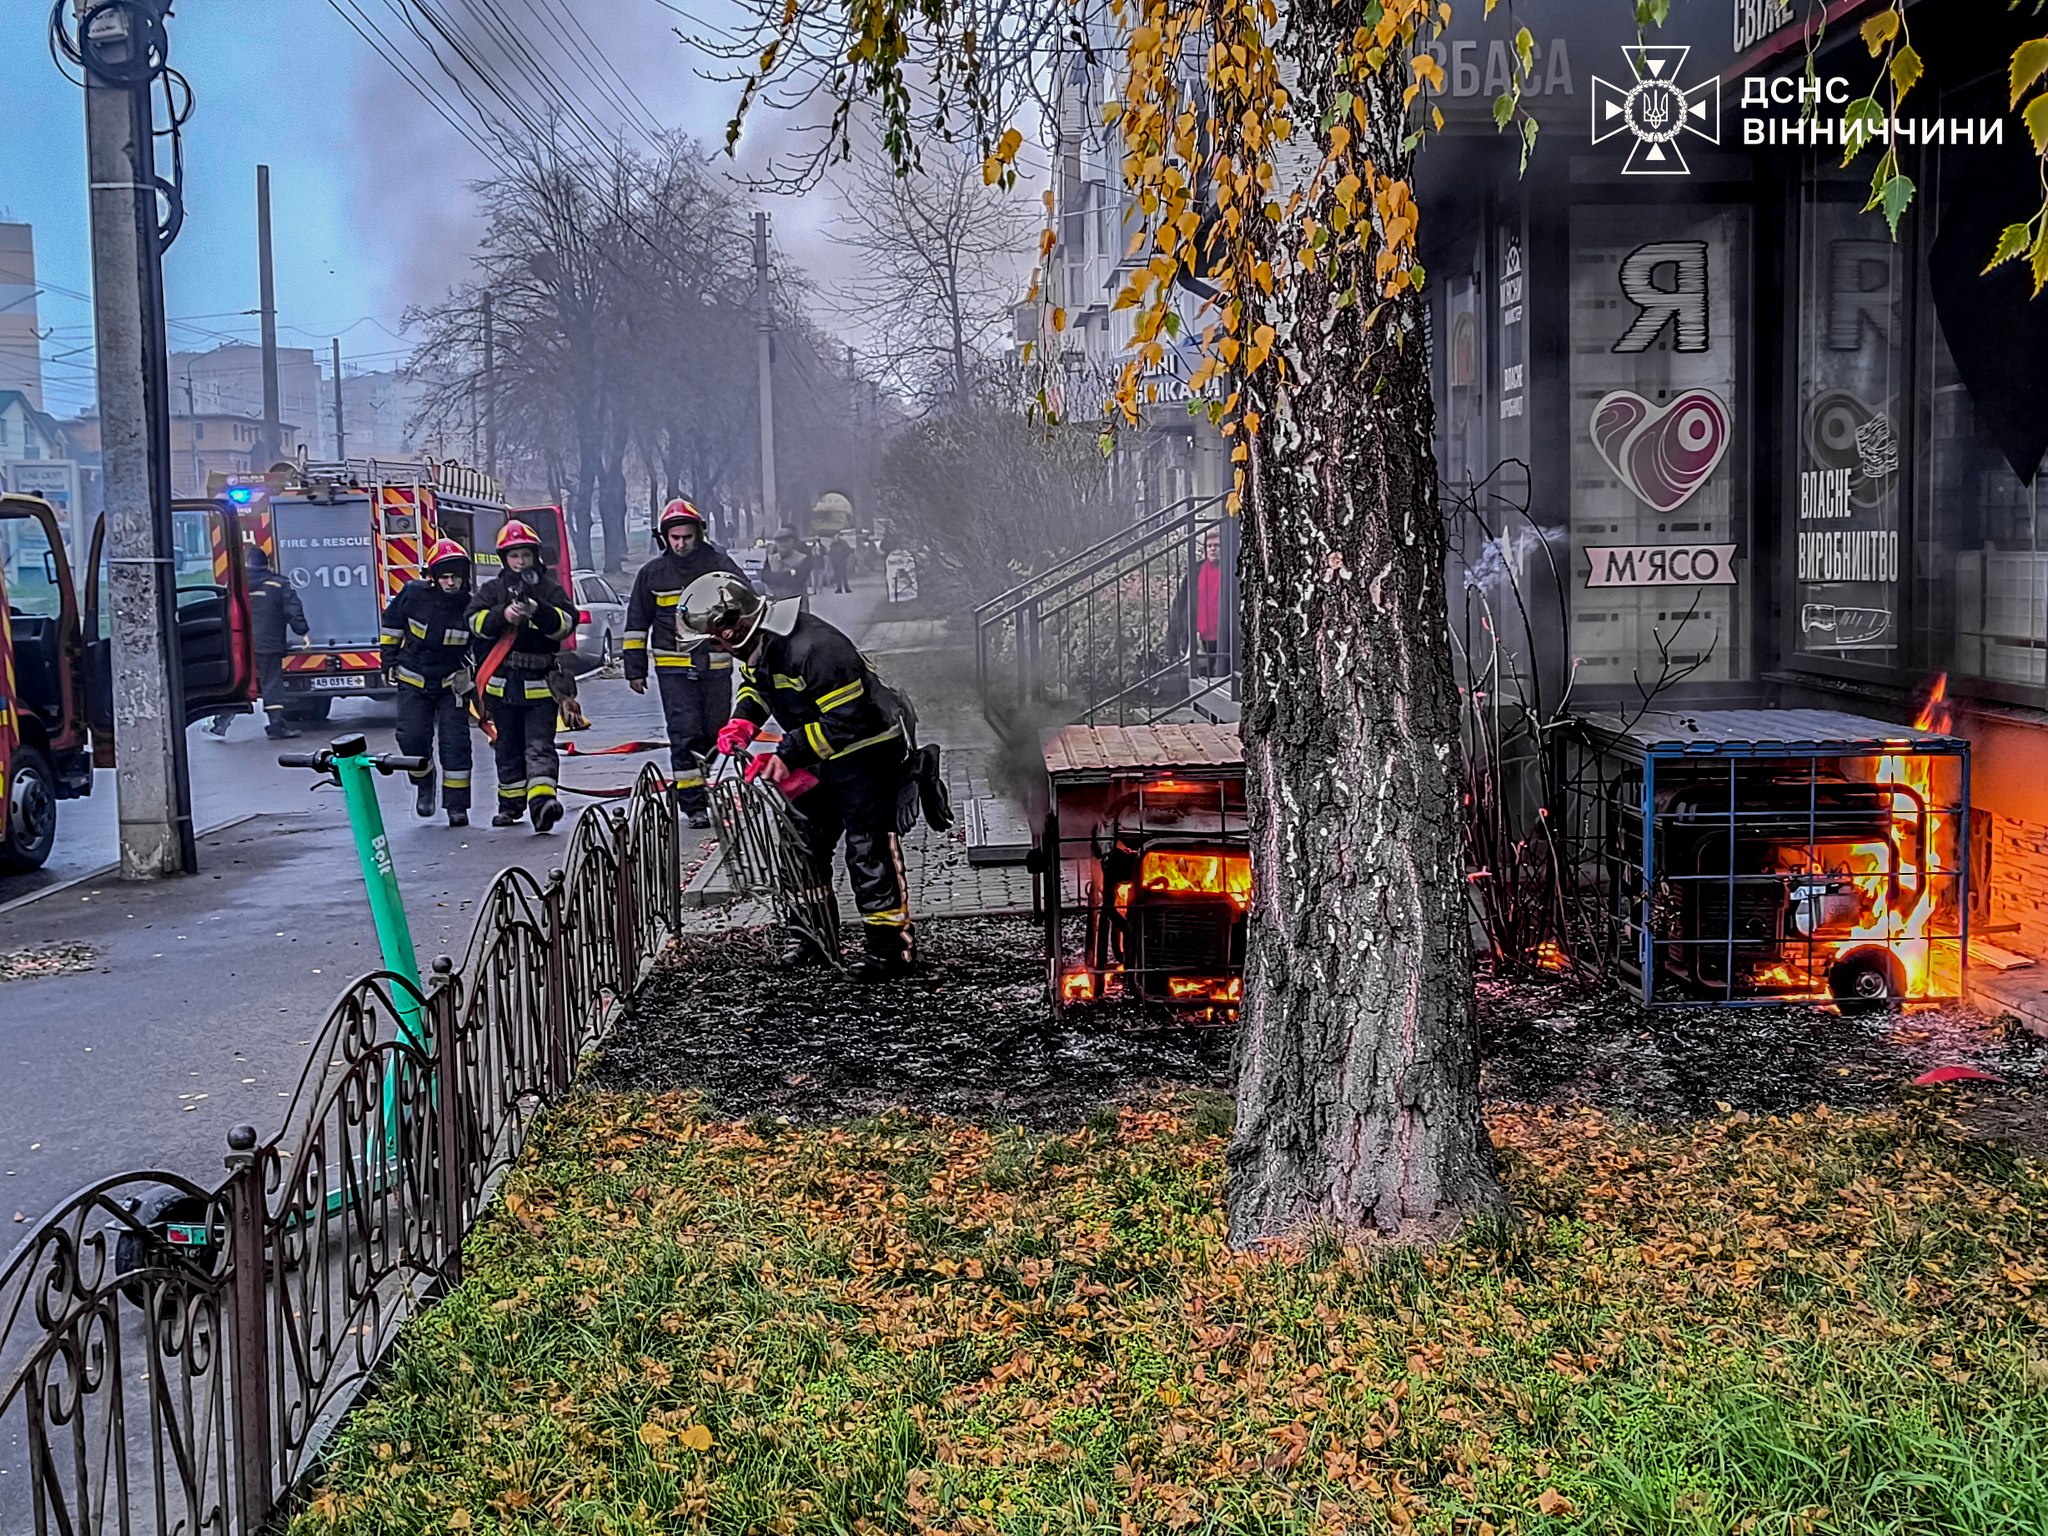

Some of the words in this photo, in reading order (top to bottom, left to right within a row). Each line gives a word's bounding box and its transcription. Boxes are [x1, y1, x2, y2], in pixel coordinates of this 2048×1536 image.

[1801, 468, 1852, 519] ВЛАСНЕ
[280, 539, 308, 549] FIRE
[311, 538, 320, 548] &
[323, 536, 371, 548] RESCUE
[1798, 530, 1899, 582] ВИРОБНИЦТВО
[315, 565, 368, 588] 101
[1605, 549, 1719, 582] М'ЯСО
[371, 835, 392, 876] Bolt
